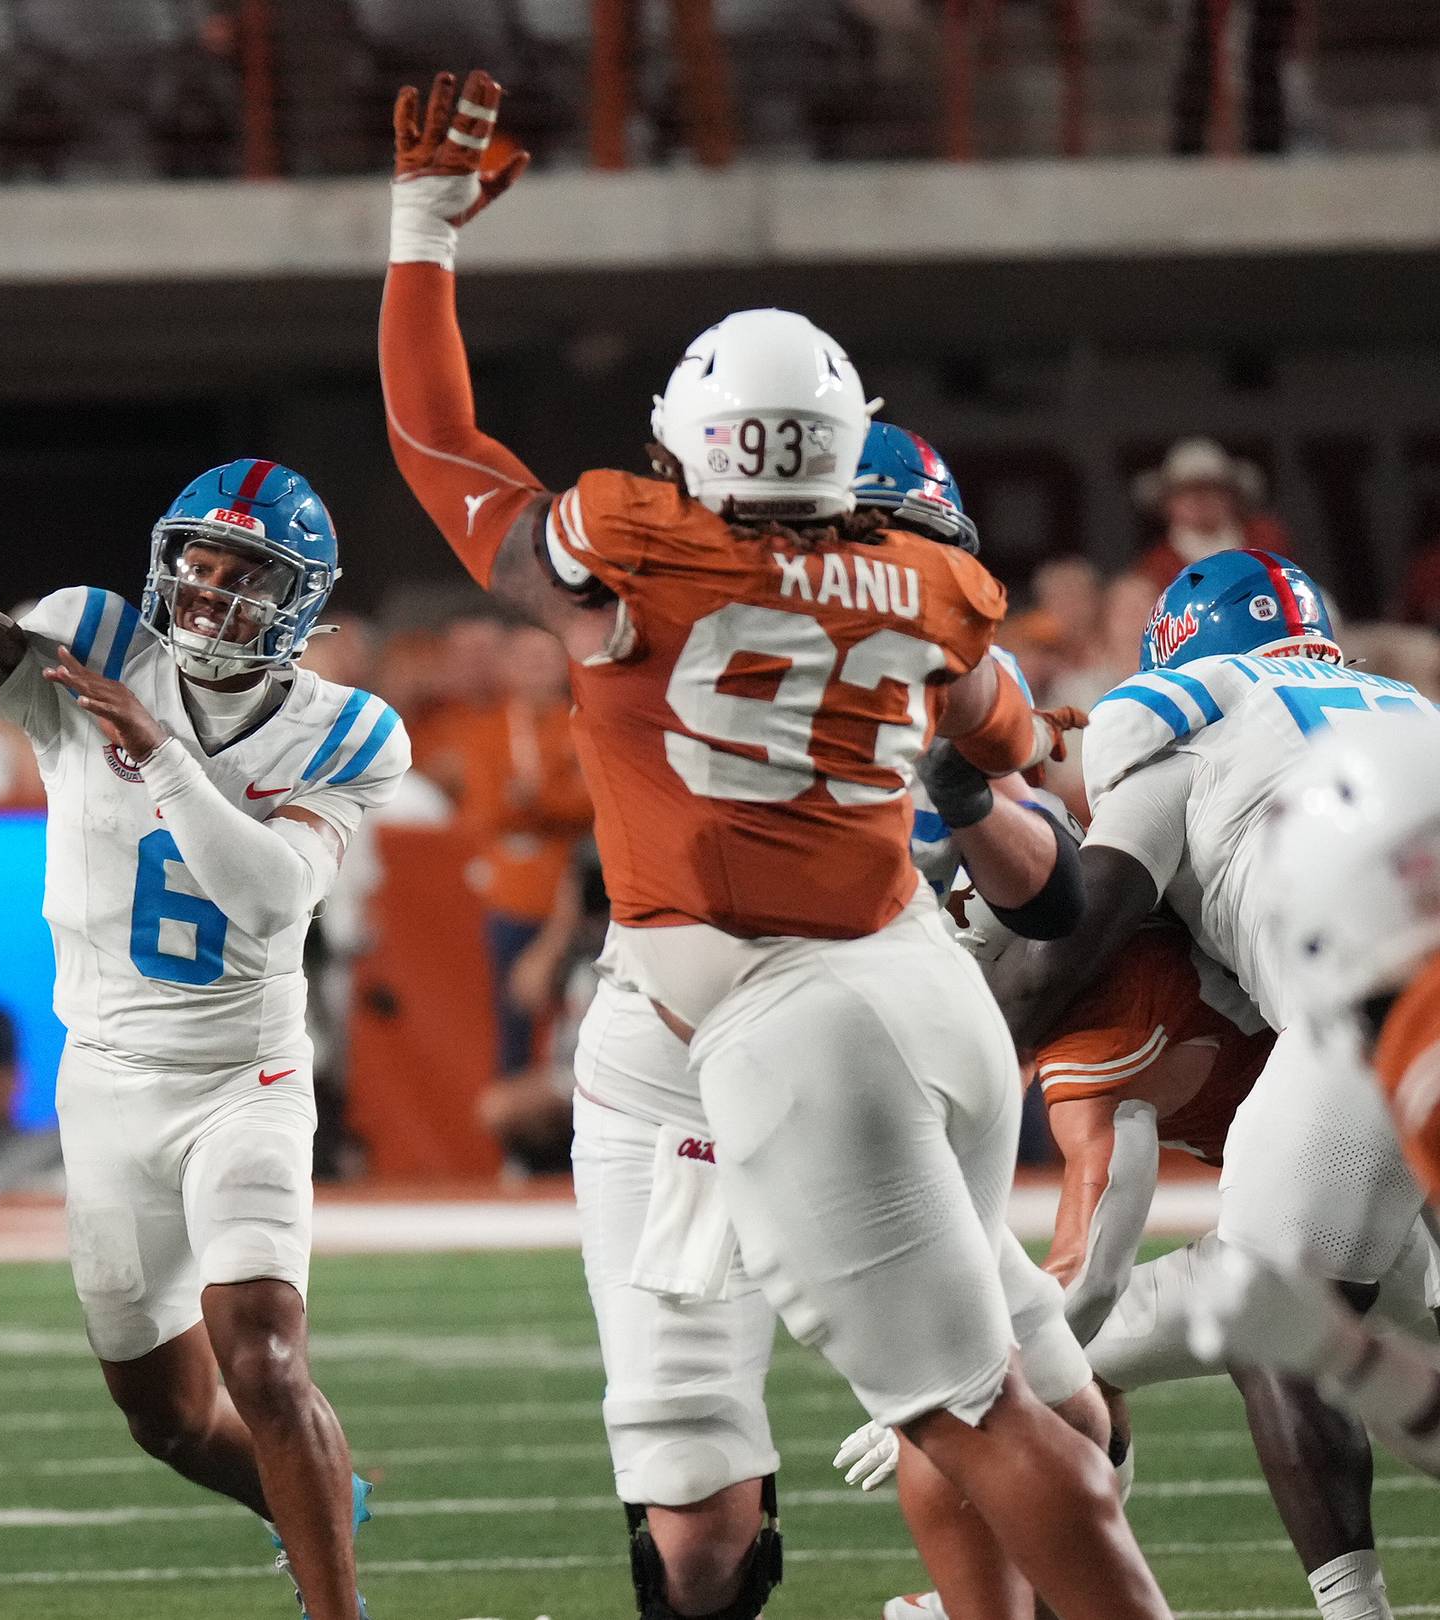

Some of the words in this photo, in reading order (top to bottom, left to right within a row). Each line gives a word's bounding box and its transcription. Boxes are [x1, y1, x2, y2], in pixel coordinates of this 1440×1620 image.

[737, 418, 802, 477] 93
[215, 509, 256, 530] REBS
[773, 552, 919, 620] KANU
[1152, 604, 1198, 664] Miss
[663, 602, 946, 806] 93
[108, 756, 142, 780] GRADUAT
[130, 828, 229, 985] 6
